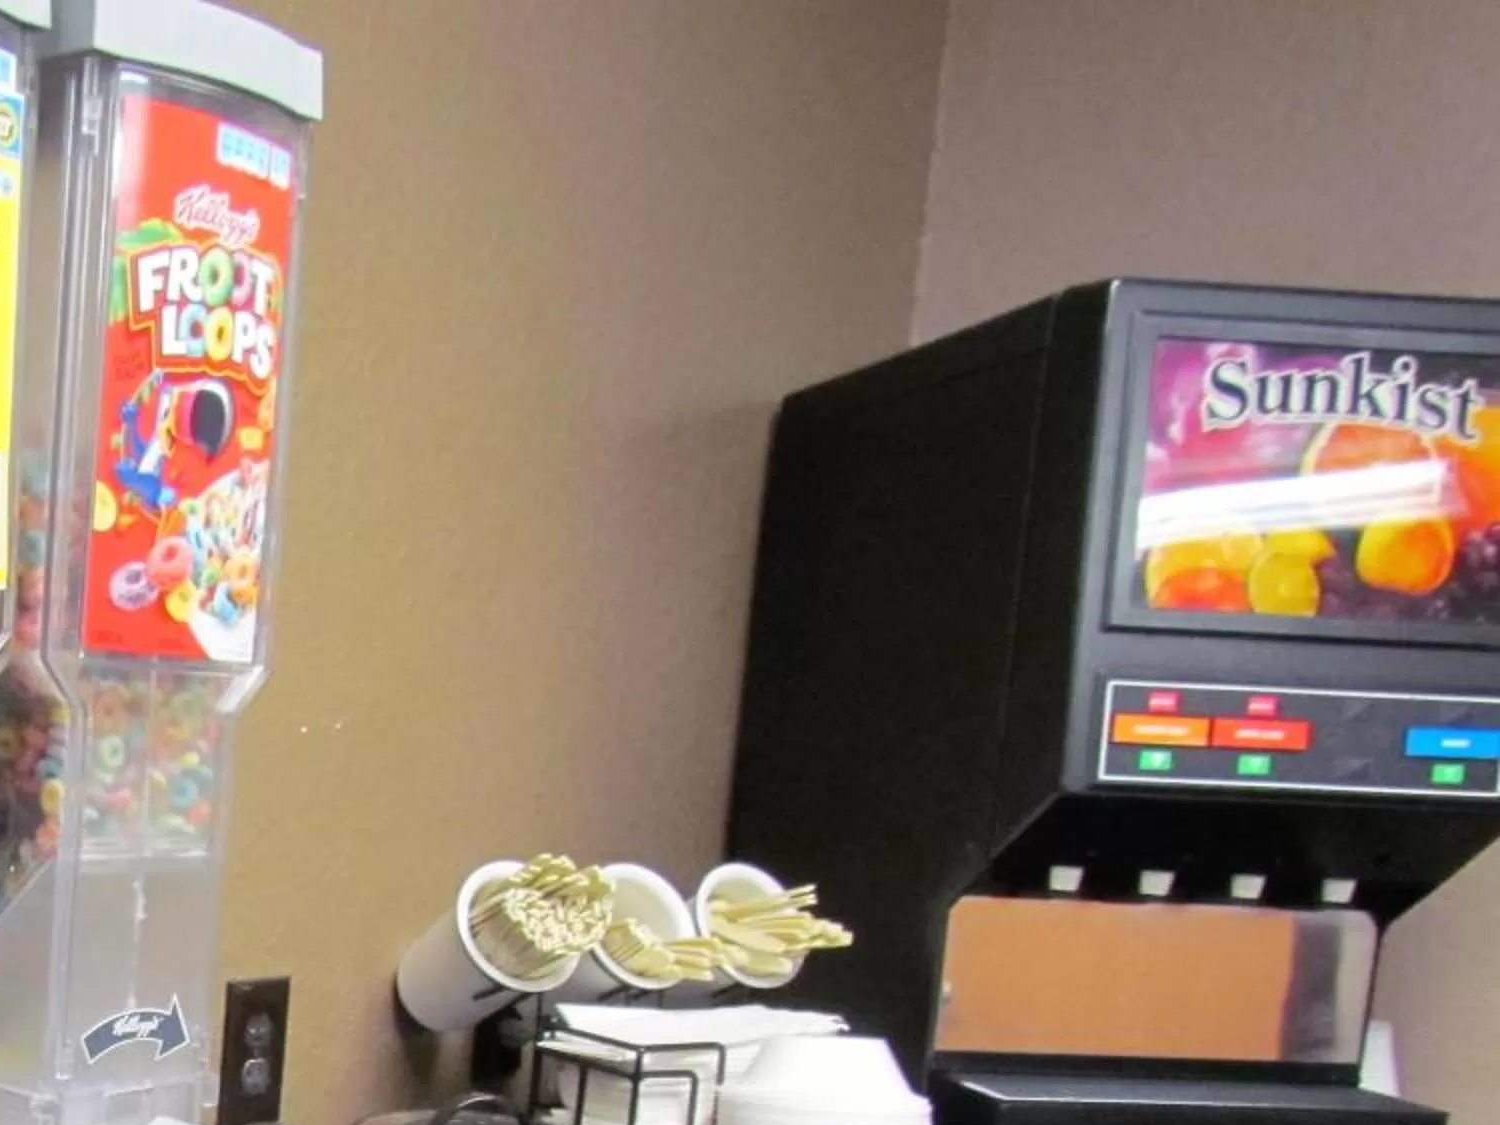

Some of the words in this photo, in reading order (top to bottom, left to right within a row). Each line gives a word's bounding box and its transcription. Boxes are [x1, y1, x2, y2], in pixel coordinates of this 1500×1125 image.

[136, 247, 276, 318] FROOT
[161, 303, 276, 379] LOOPS
[1205, 350, 1483, 441] Sunkist
